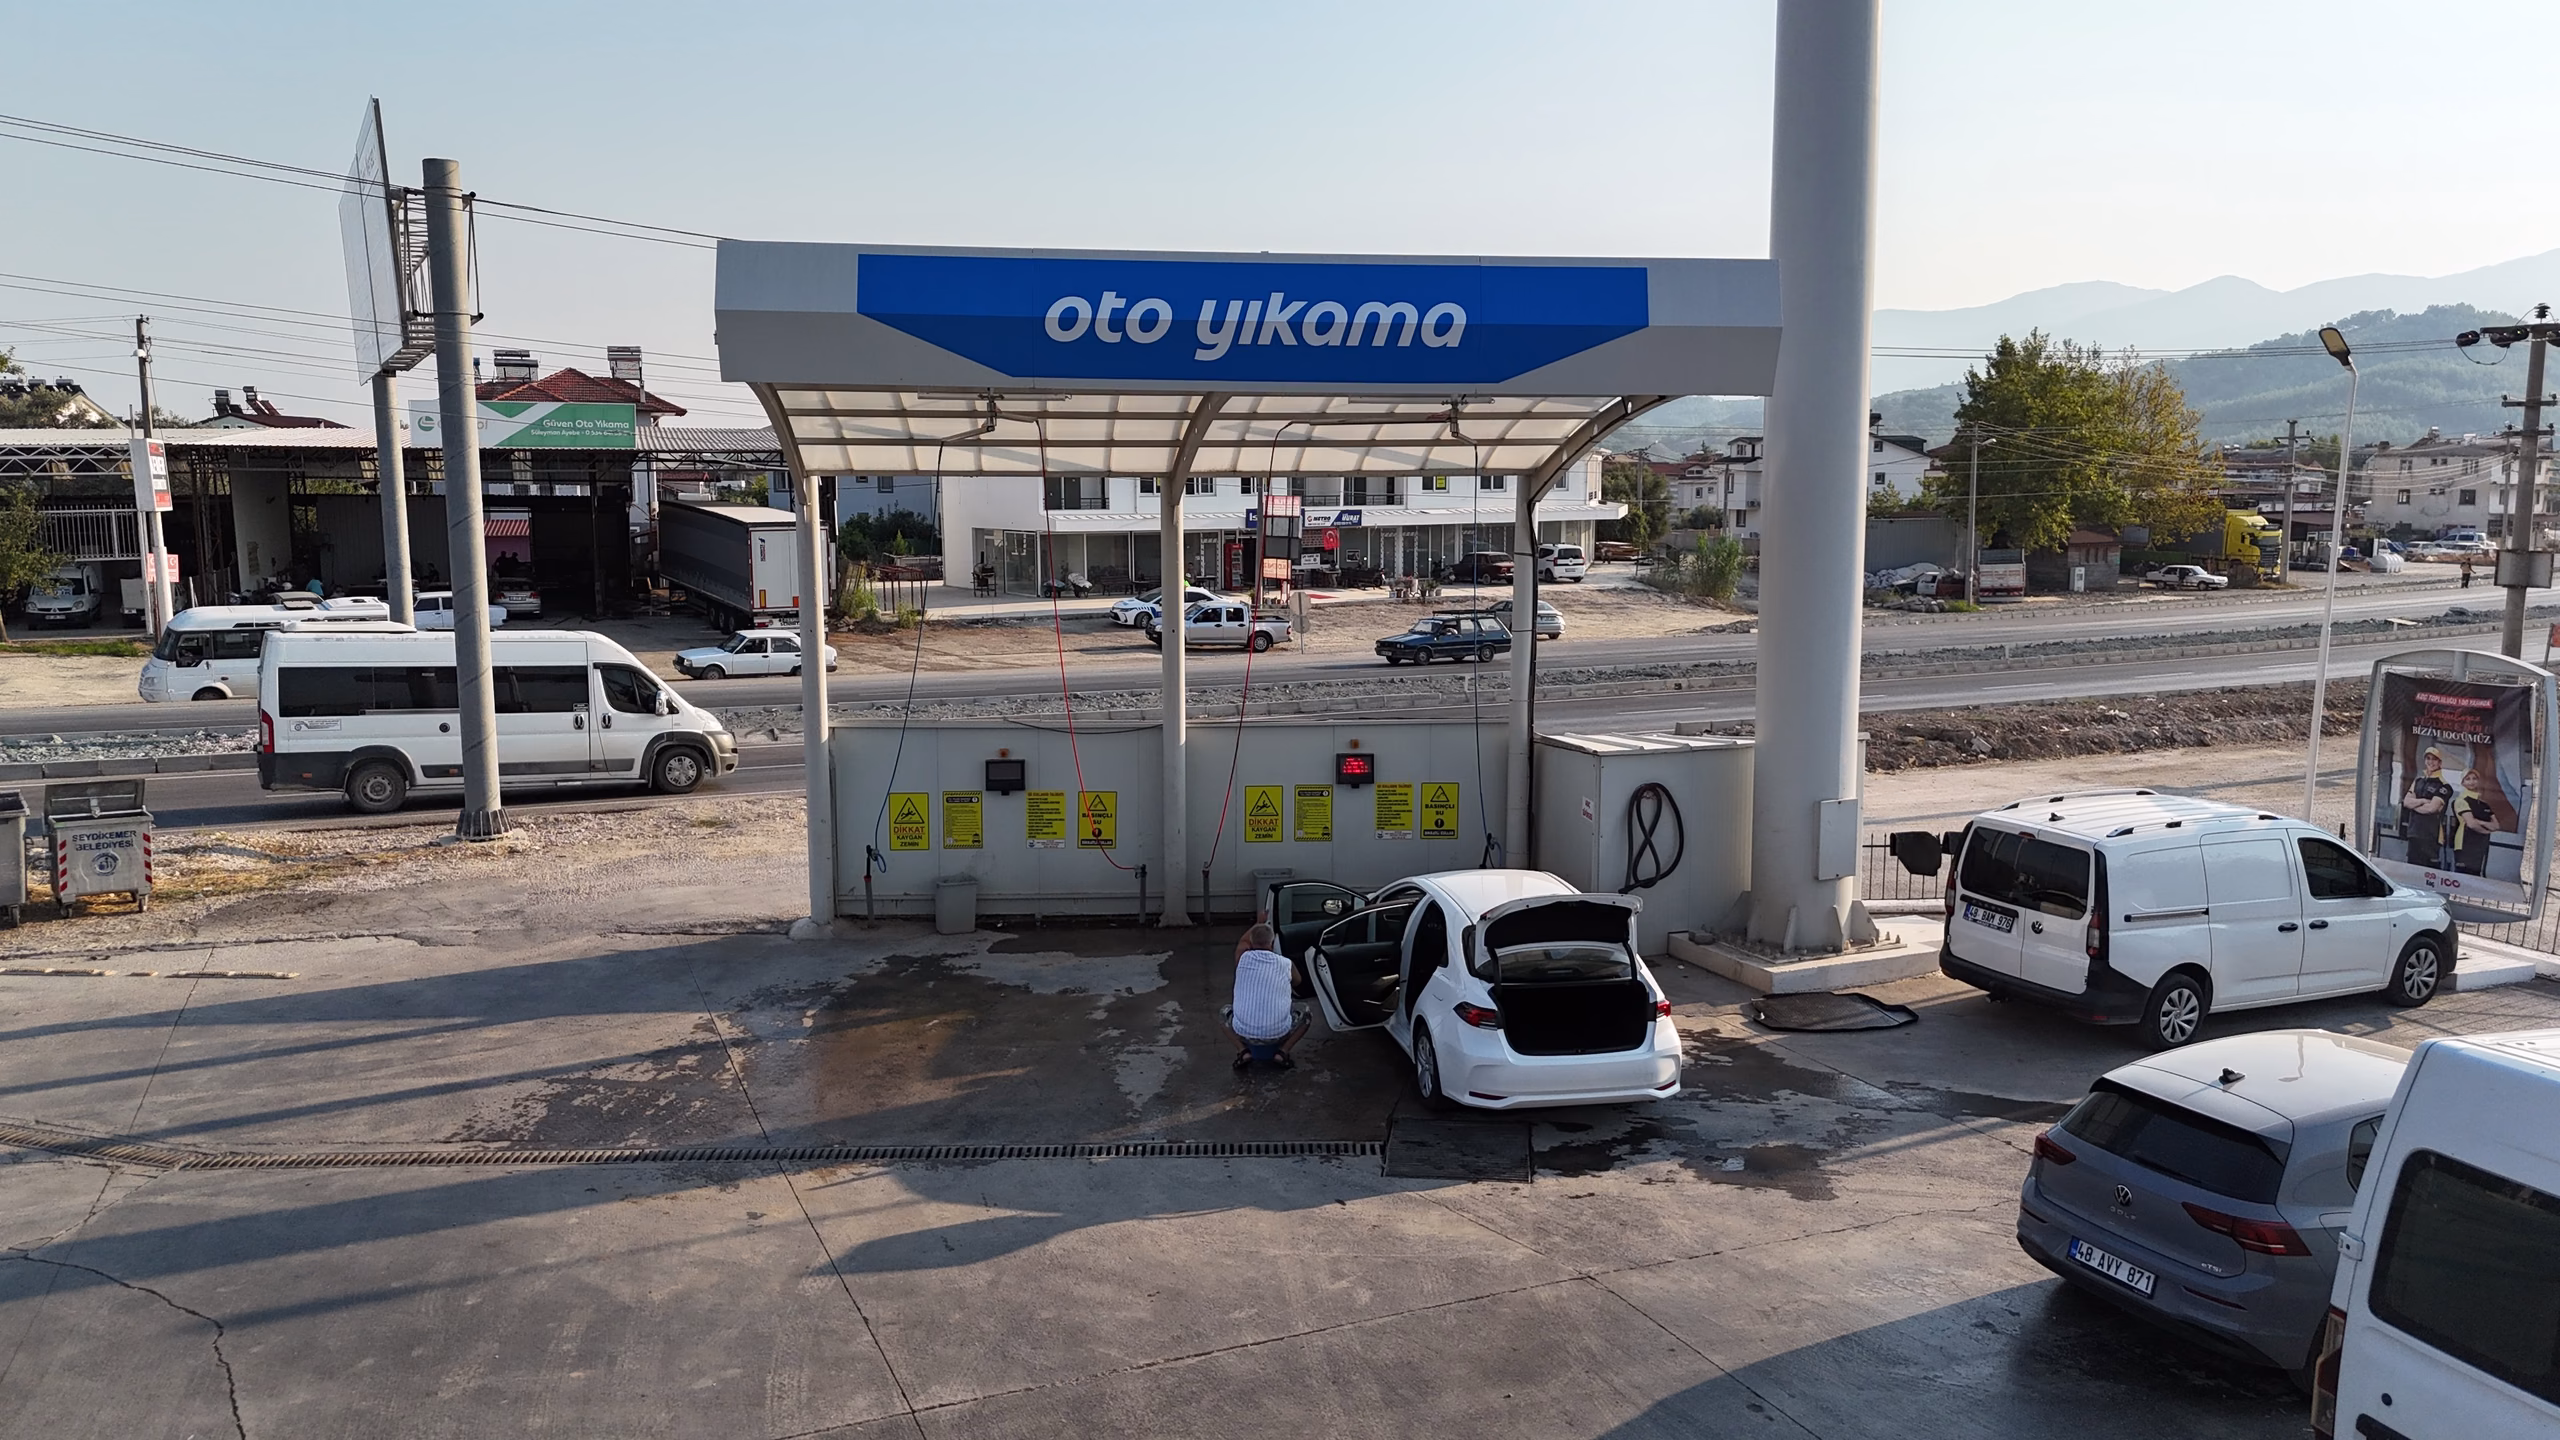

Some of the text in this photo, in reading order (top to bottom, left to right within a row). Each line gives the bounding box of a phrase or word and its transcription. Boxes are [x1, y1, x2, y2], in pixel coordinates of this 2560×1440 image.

[1044, 291, 1467, 361] oto yıkama
[543, 419, 629, 429] Güven Oto Yıkama
[2412, 725, 2441, 737] BİZİM
[1248, 817, 1279, 826] DİKKAT
[893, 824, 925, 834] DİKKAT
[72, 830, 137, 842] SEYDİKEMER
[75, 838, 134, 851] BELEDİYESİ
[1981, 910, 1996, 924] BAM
[1997, 915, 2012, 929] 976
[2077, 1242, 2152, 1291] 48 AVY 871
